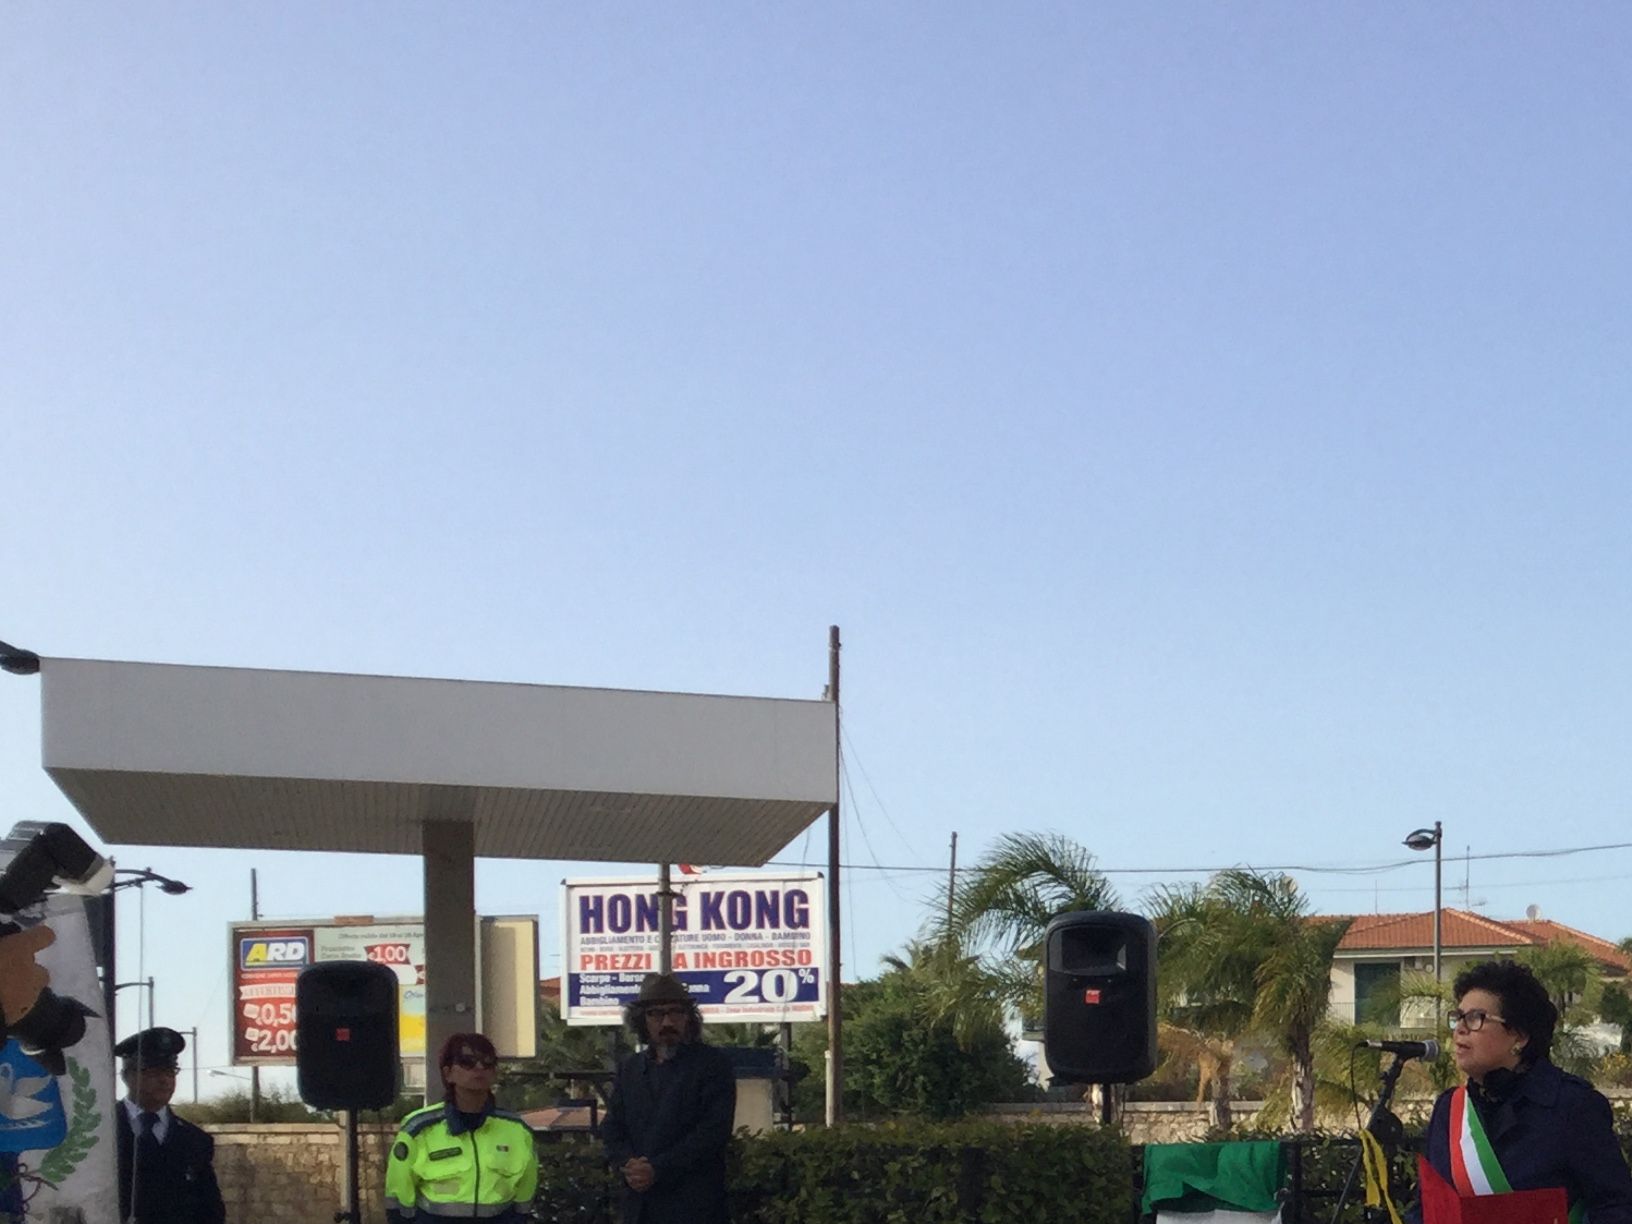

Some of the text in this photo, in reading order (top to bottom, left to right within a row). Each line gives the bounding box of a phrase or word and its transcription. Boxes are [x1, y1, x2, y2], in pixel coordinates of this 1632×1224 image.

[579, 889, 810, 934] HONG KONG
[702, 933, 726, 942] UOMO
[734, 932, 763, 941] DONNA
[771, 931, 811, 941] BAMBINO
[246, 942, 305, 962] ARD
[580, 953, 652, 971] PREZZI
[694, 949, 813, 969] INGROSSO
